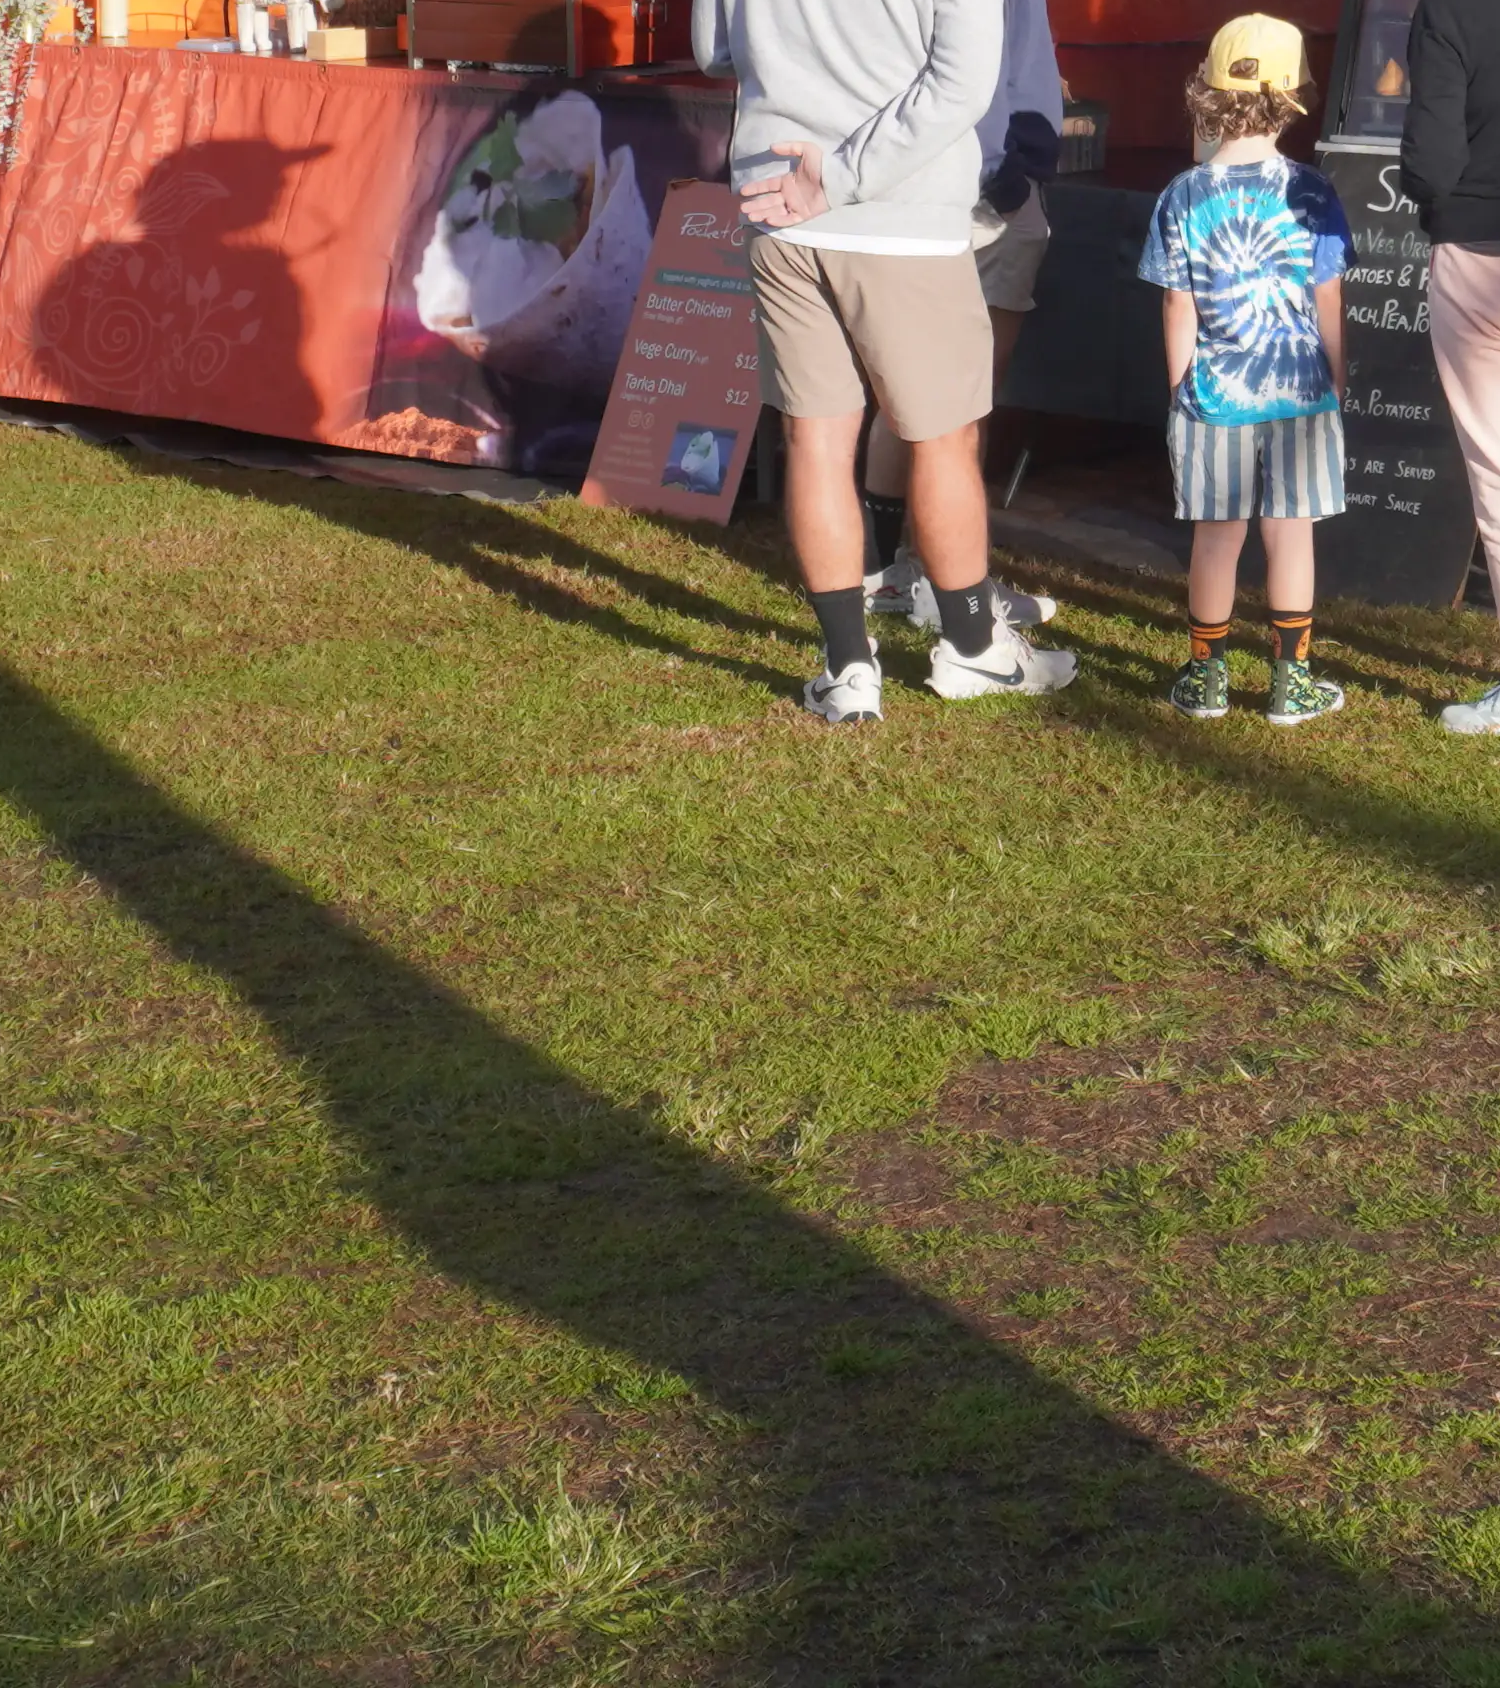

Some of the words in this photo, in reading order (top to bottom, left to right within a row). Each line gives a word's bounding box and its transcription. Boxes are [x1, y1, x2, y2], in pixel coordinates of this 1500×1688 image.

[680, 212, 731, 240] Pocket
[1398, 264, 1414, 287] &
[646, 293, 684, 313] Butter
[685, 298, 732, 319] Chicken
[1346, 306, 1380, 329] ACH,
[634, 338, 663, 359] Vege
[664, 342, 697, 365] Curry
[735, 352, 758, 370] $12
[625, 373, 656, 392] Tarka
[658, 378, 687, 396] Dhal
[725, 387, 749, 405] $12
[1364, 460, 1385, 475] ARE
[1394, 461, 1436, 481] SERVED
[1385, 493, 1422, 515] SAUCE
